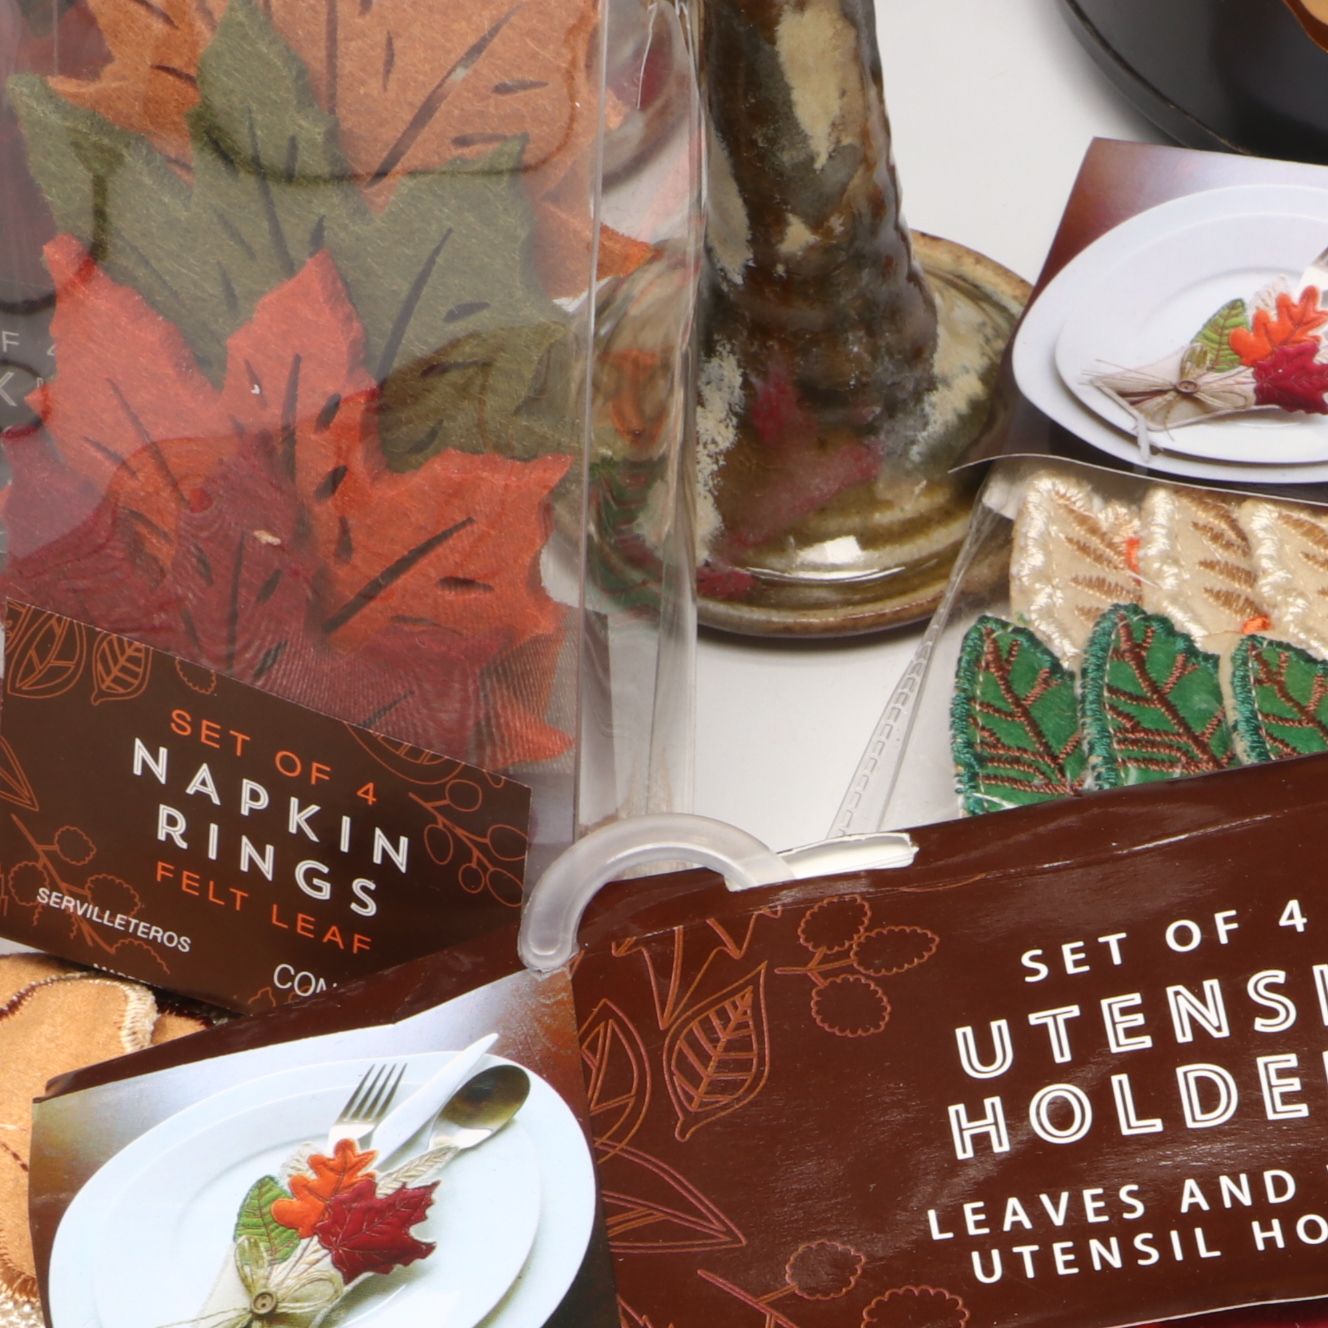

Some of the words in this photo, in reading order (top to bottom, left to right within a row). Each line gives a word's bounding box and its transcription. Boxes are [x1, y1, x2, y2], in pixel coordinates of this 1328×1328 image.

[169, 708, 252, 758] SET
[274, 750, 332, 786] OF
[356, 780, 378, 807] 4
[132, 737, 411, 874] NAPKIN
[156, 802, 379, 918] RINGS
[35, 887, 193, 955] SERVILLETEROS
[154, 862, 250, 913] FELT
[271, 904, 373, 956] LEAF
[1020, 932, 1128, 984] SET
[1164, 909, 1240, 954] OF
[1278, 898, 1308, 933] 4
[926, 1183, 1146, 1242] LEAVES
[1180, 1168, 1298, 1215] AND
[970, 1226, 1222, 1285] UTENSIL
